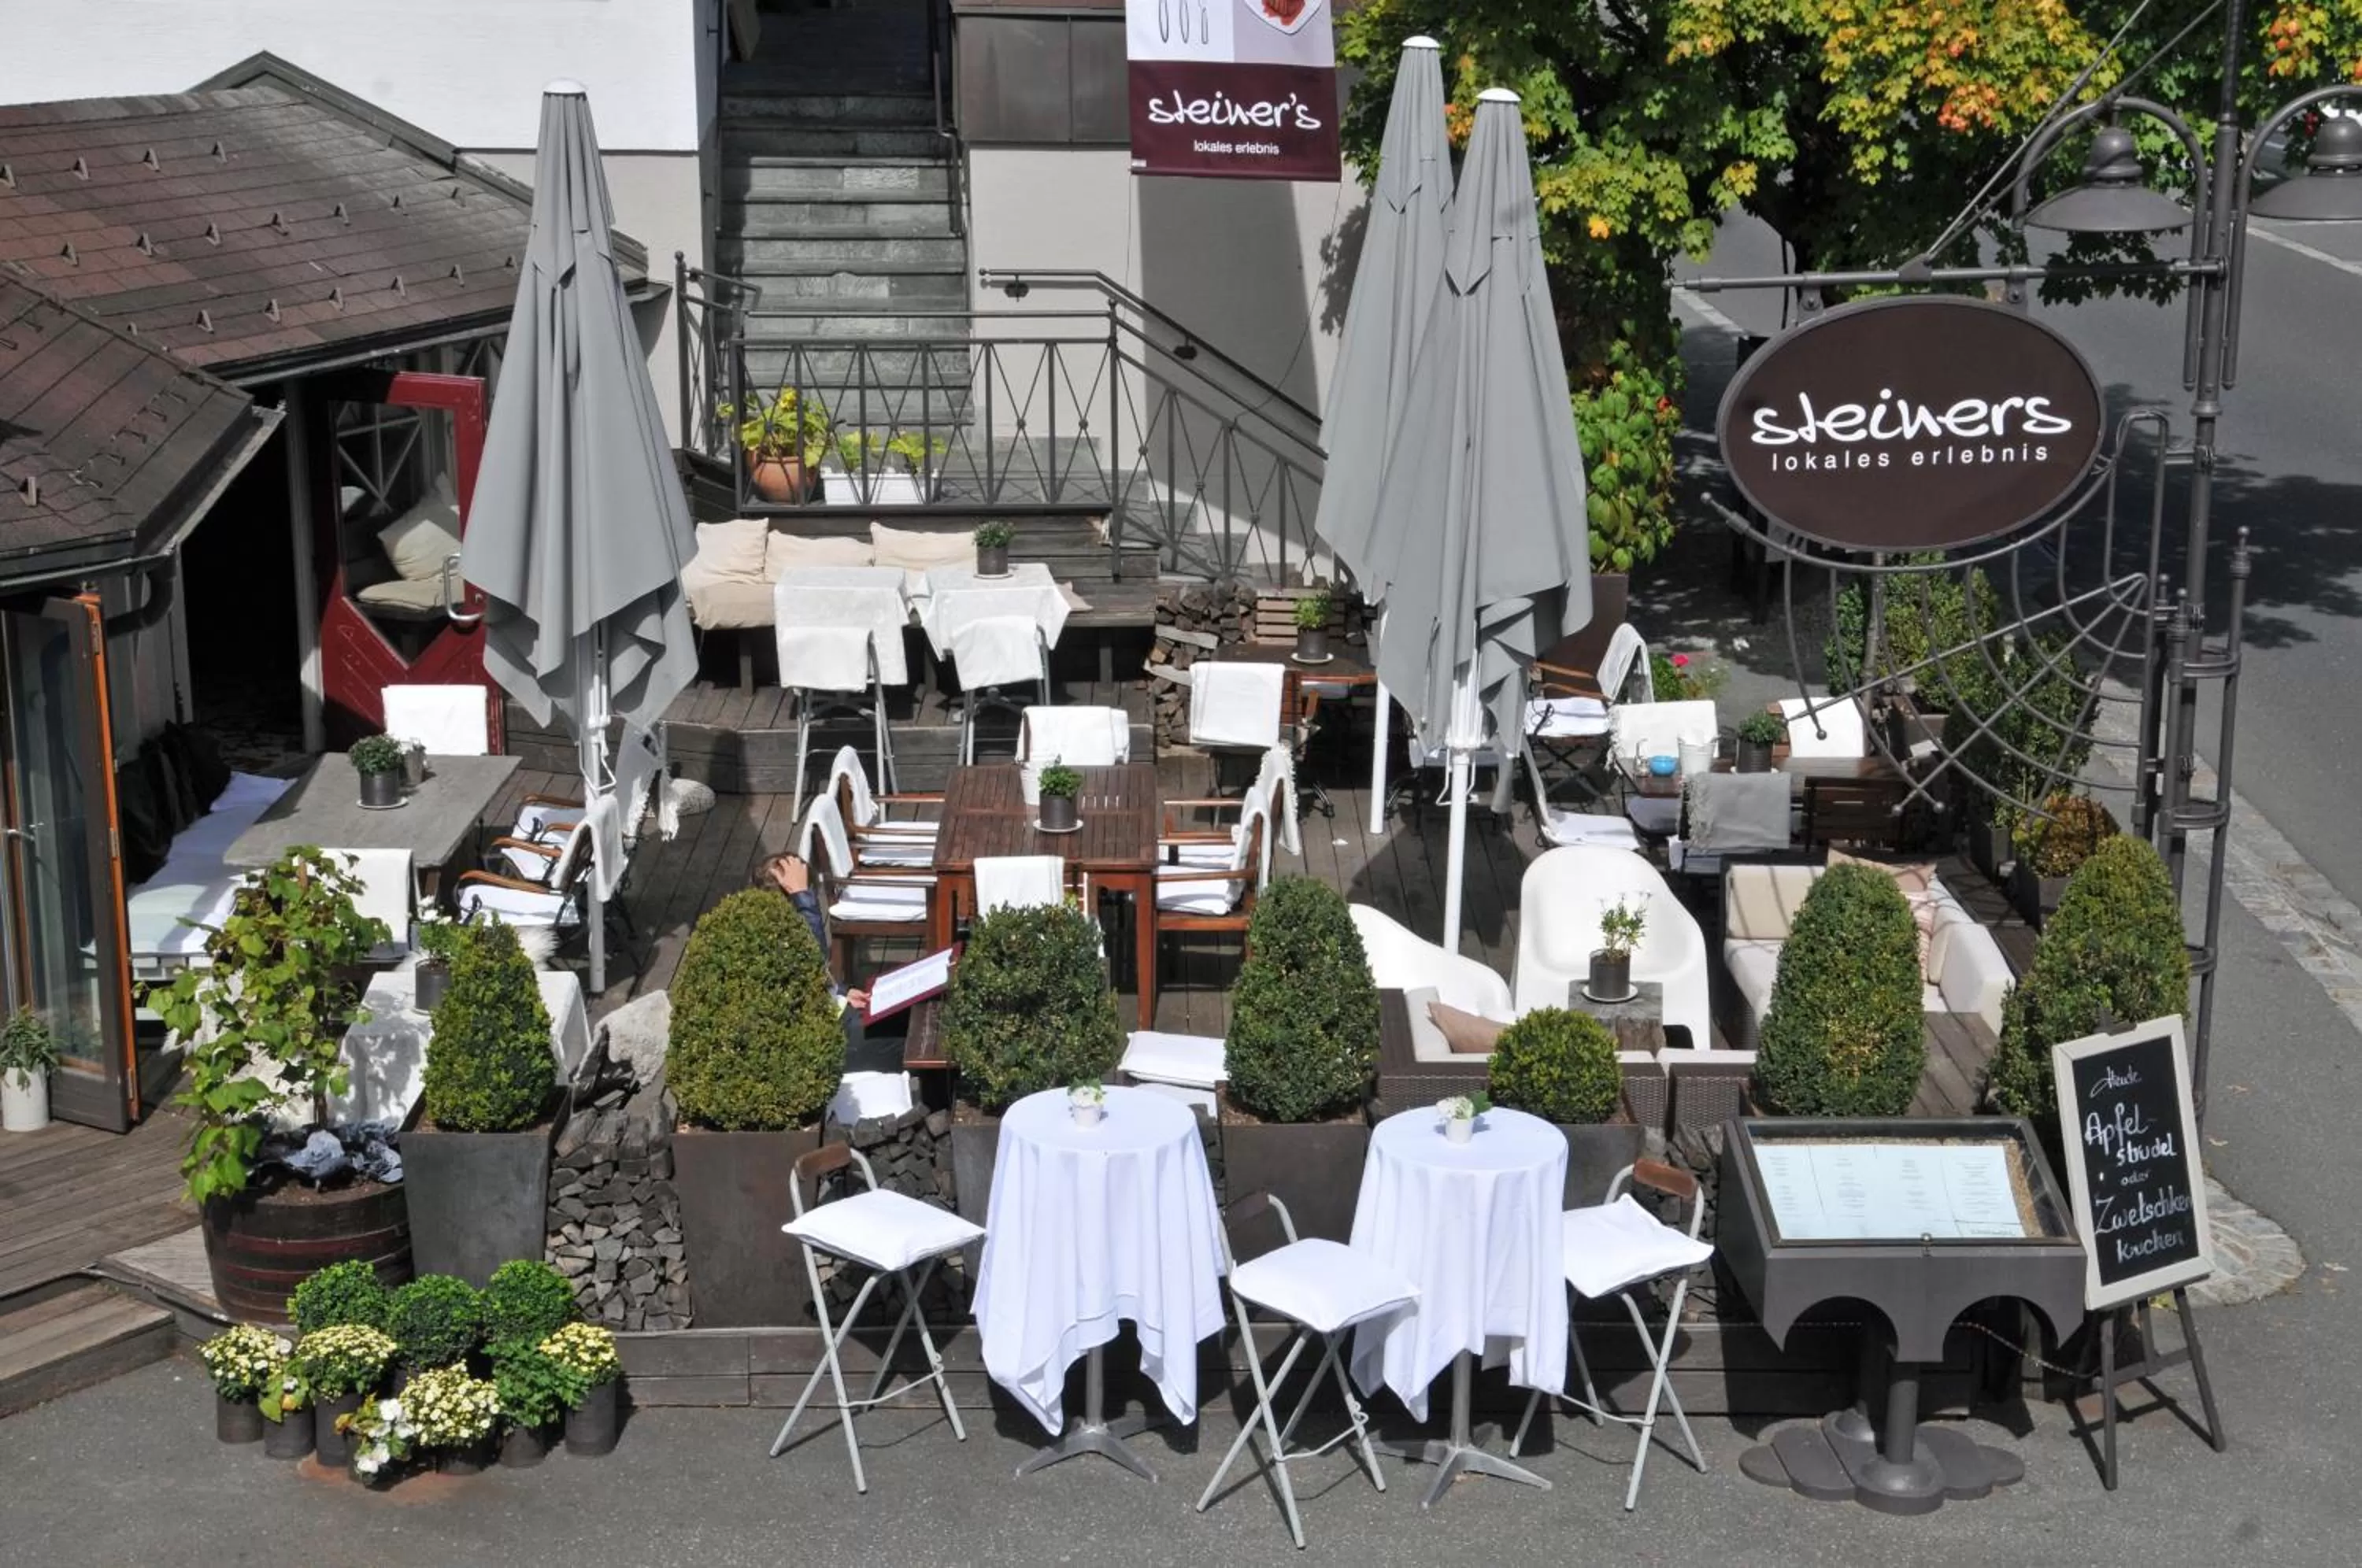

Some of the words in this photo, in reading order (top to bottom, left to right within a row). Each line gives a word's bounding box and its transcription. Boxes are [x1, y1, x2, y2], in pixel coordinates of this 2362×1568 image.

[1148, 89, 1322, 129] steiner's
[1194, 139, 1232, 153] lokales
[1235, 142, 1279, 155] erlebnis
[1751, 388, 2071, 445] steiners
[1772, 449, 1890, 472] lokales
[1911, 443, 2048, 466] erlebnis
[2116, 1132, 2177, 1167] strudel
[2120, 1170, 2151, 1186] oder
